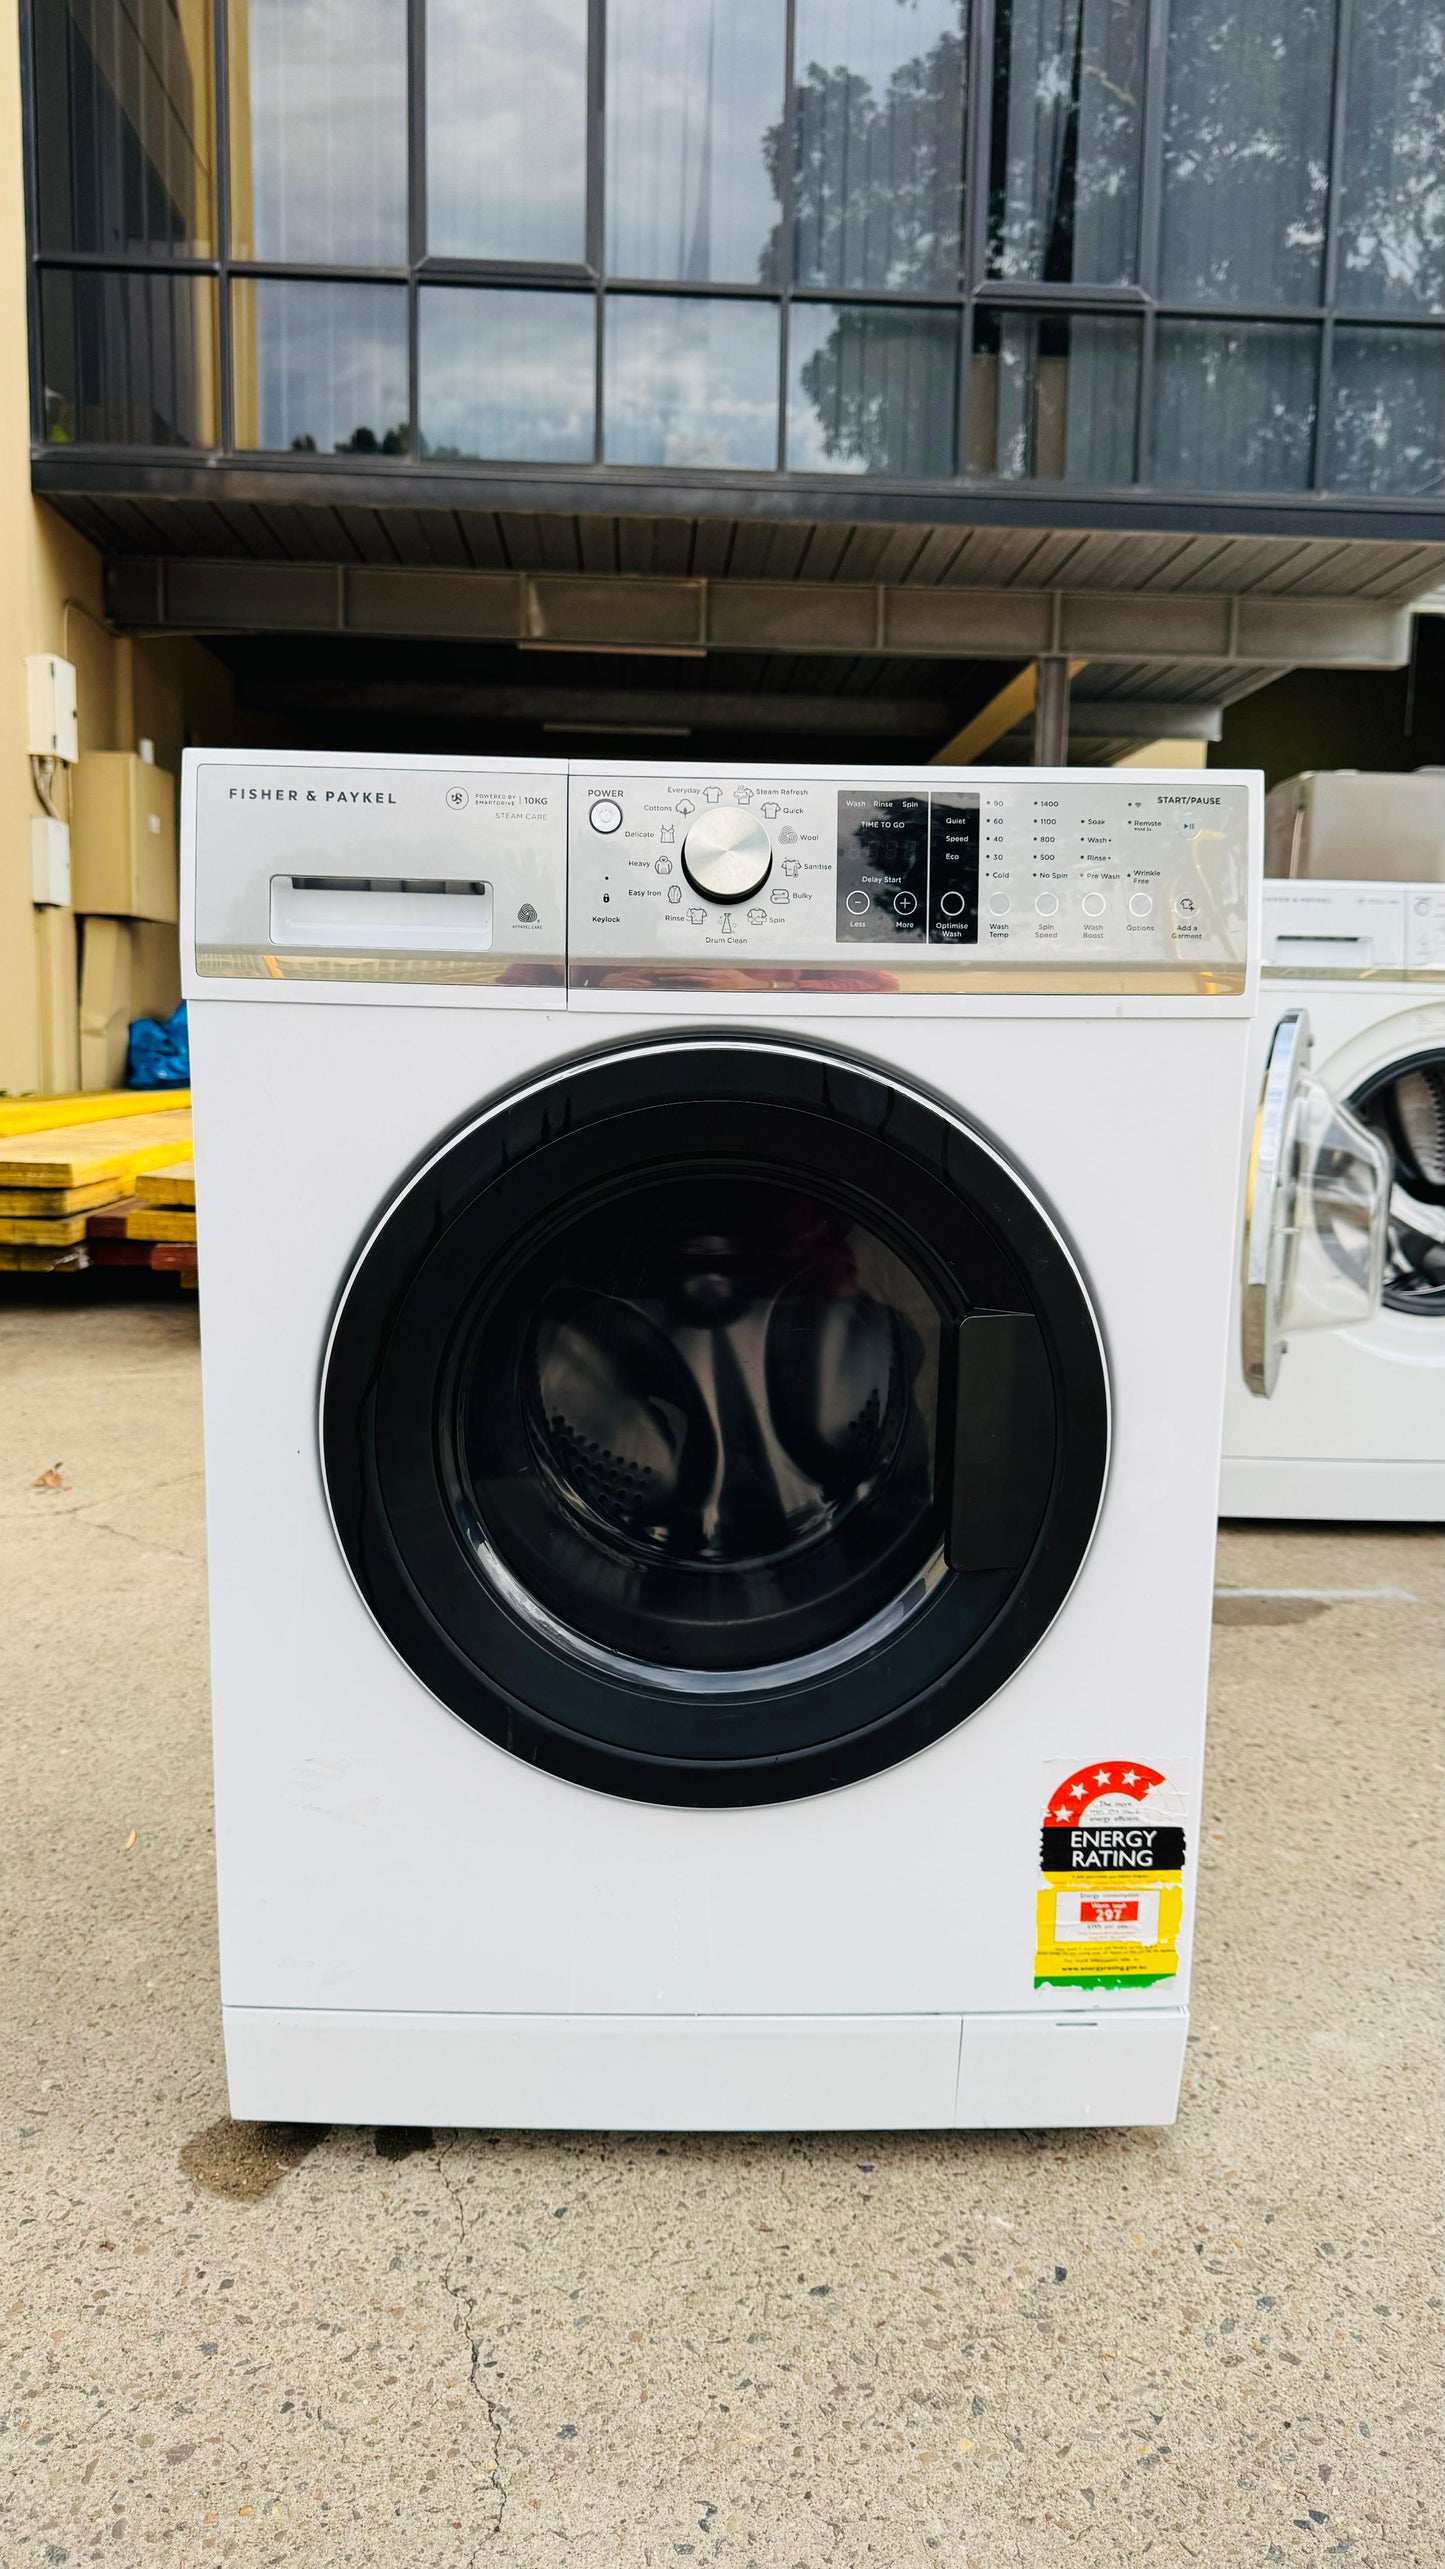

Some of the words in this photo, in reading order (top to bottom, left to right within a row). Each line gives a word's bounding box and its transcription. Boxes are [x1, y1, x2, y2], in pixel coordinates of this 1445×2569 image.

[588, 790, 624, 798] POWER
[668, 786, 700, 794] Everyday
[229, 788, 298, 801] FISHER
[306, 790, 317, 802] &
[326, 790, 397, 804] PAYKEL
[524, 796, 548, 805] 10KG
[1157, 796, 1222, 805] START/PAUSE
[1070, 1830, 1158, 1848] ENERGY
[1072, 1850, 1154, 1868] RATING
[1096, 1909, 1122, 1921] 297
